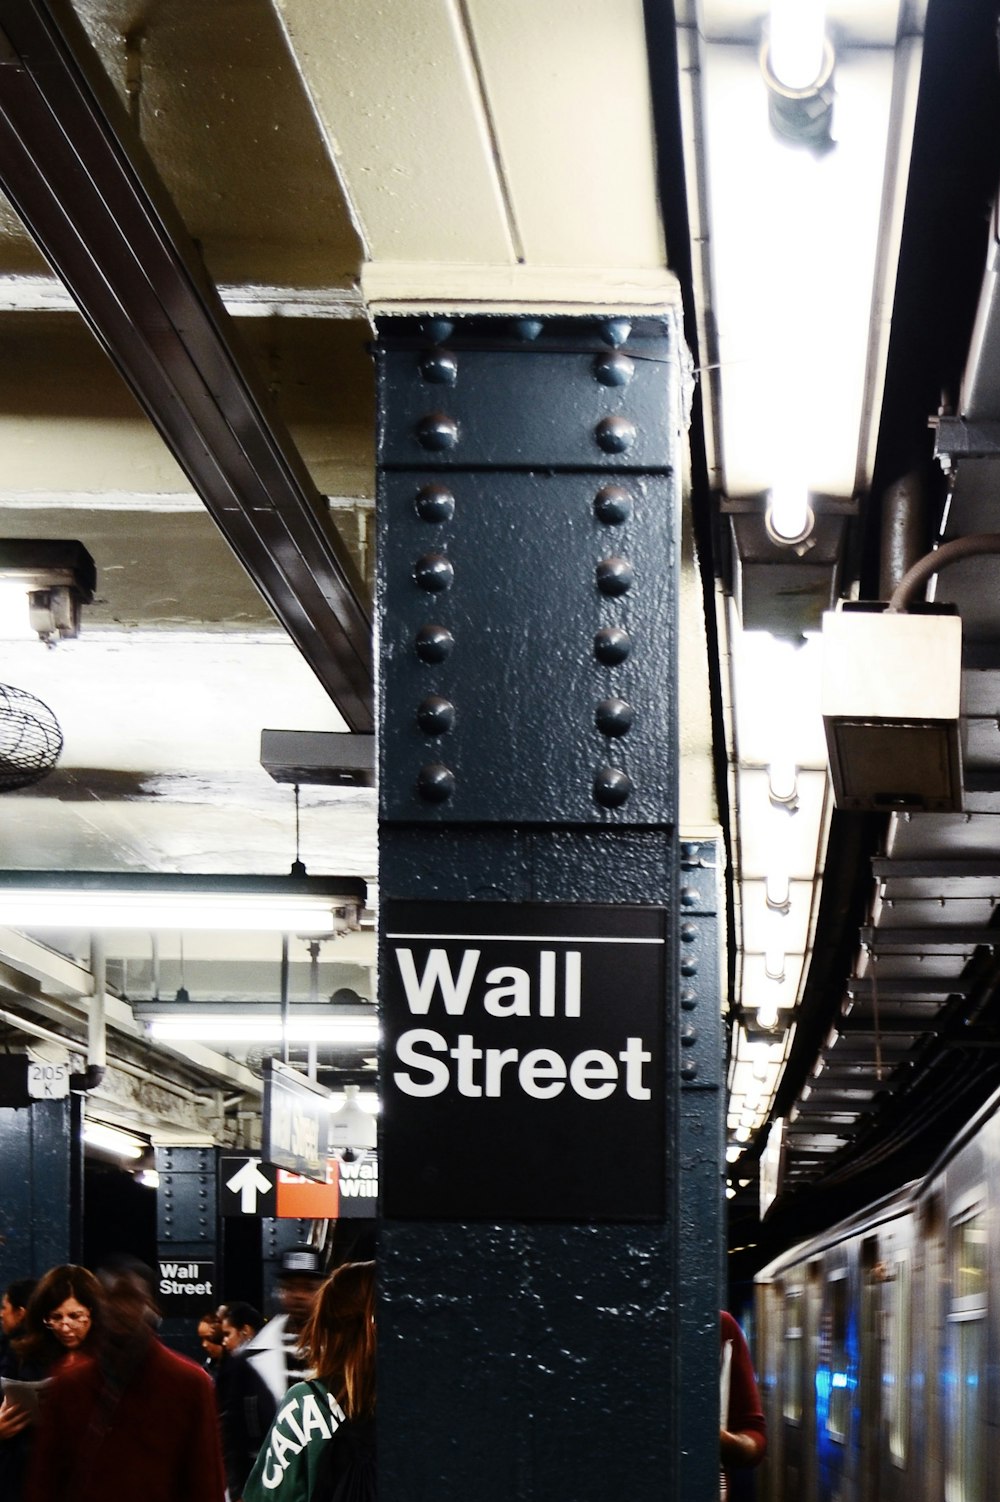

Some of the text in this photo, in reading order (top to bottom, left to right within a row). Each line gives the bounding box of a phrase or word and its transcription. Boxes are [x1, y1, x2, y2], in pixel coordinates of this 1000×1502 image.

[395, 948, 582, 1018] Wall
[393, 1028, 652, 1100] Street
[159, 1280, 212, 1295] Street
[160, 1264, 199, 1279] Wall
